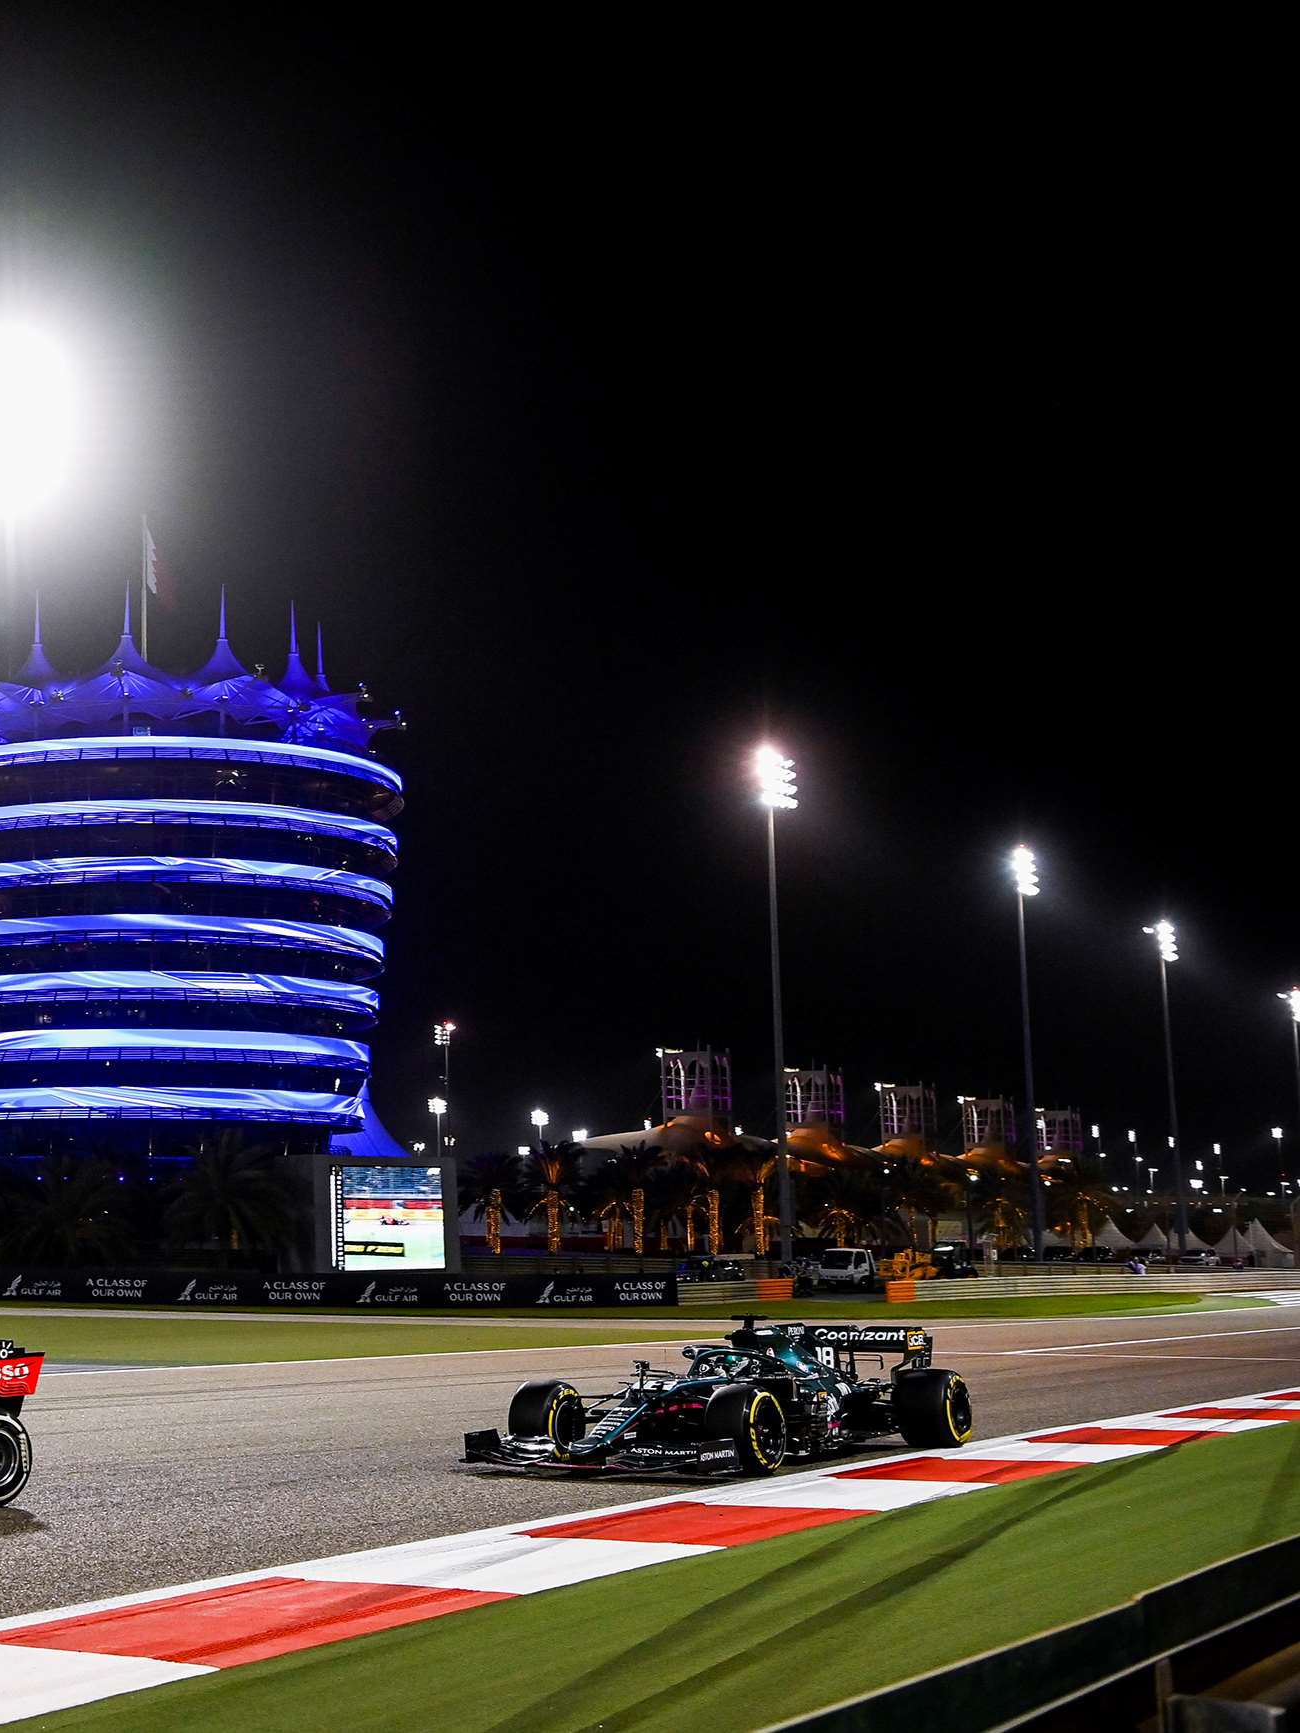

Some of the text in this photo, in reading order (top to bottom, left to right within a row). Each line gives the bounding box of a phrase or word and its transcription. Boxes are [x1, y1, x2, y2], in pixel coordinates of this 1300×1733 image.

[86, 1278, 148, 1287] A CLASS OF
[273, 1281, 309, 1290] CLASS
[312, 1282, 326, 1290] OF
[443, 1283, 506, 1291] A CLASS OF
[614, 1281, 666, 1290] A CLASS OF
[92, 1288, 142, 1297] OUR OWN
[195, 1292, 220, 1300] GULF
[268, 1292, 321, 1300] OUR OWN
[642, 1292, 662, 1300] OWN
[375, 1294, 418, 1302] GULF AIR
[449, 1293, 501, 1302] OUR OWN
[814, 1328, 906, 1346] Cognizant
[908, 1334, 926, 1346] JCB
[815, 1346, 835, 1369] 18
[630, 1447, 662, 1455] ASTON
